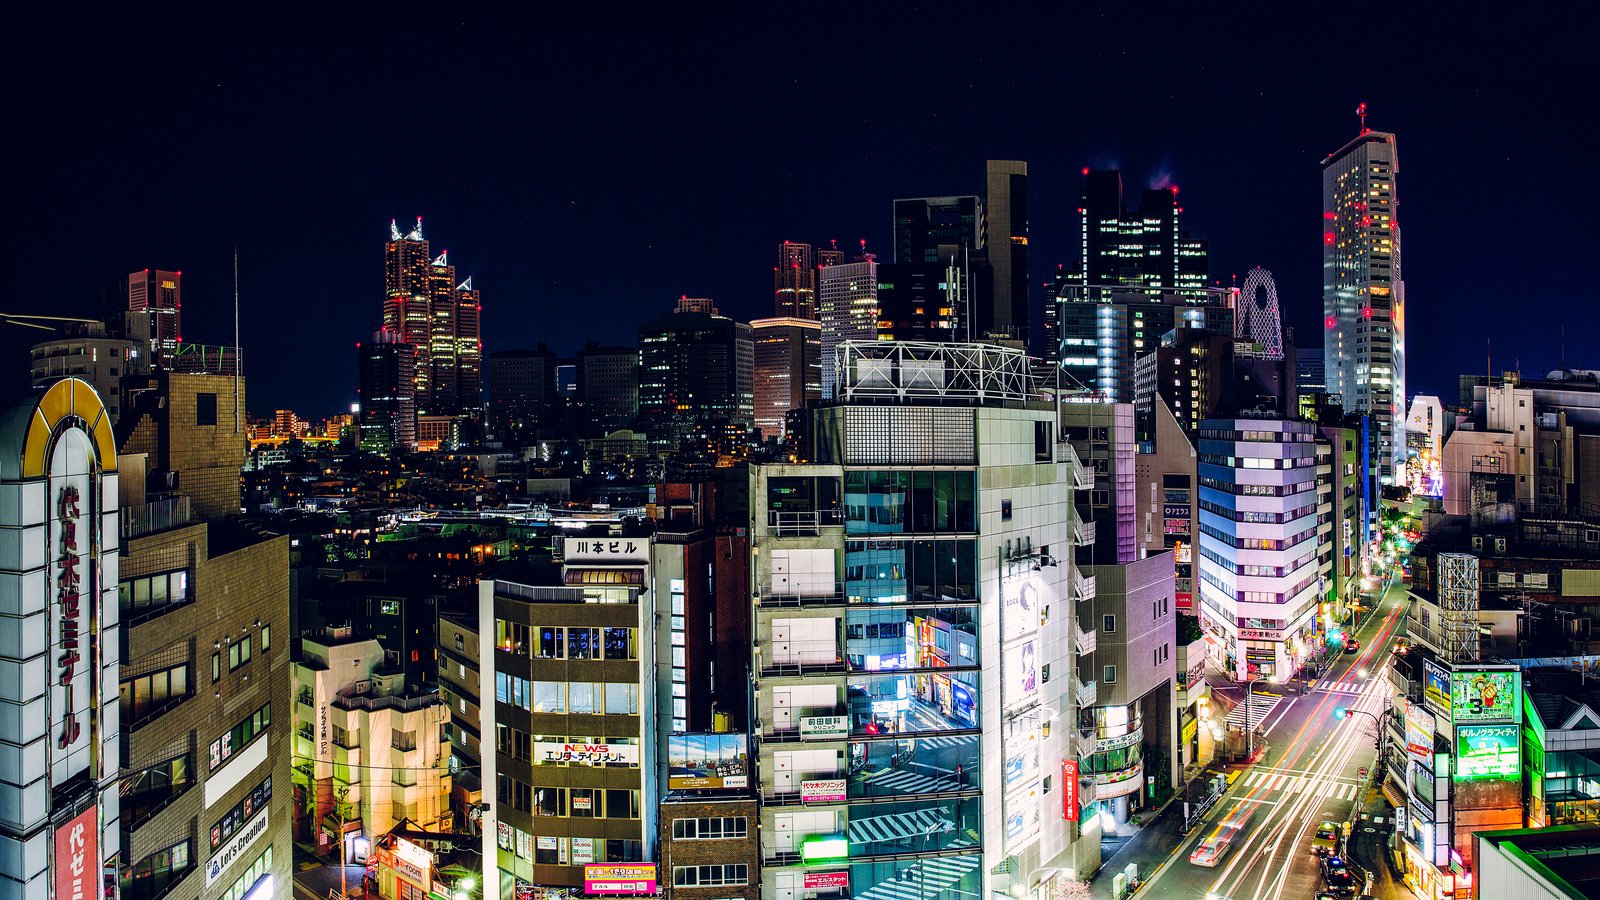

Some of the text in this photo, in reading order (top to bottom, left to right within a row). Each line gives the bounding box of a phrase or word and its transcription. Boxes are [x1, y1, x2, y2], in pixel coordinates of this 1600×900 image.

[577, 541, 637, 554] 川本ビル
[1241, 630, 1281, 638] 代々木駅前ビル
[1469, 698, 1483, 714] 3
[1460, 728, 1516, 737] ポルノグラフィティ
[564, 744, 609, 752] NEWS
[220, 845, 237, 868] Let's
[238, 816, 266, 851] Creation
[69, 822, 85, 900] 代ゼミ
